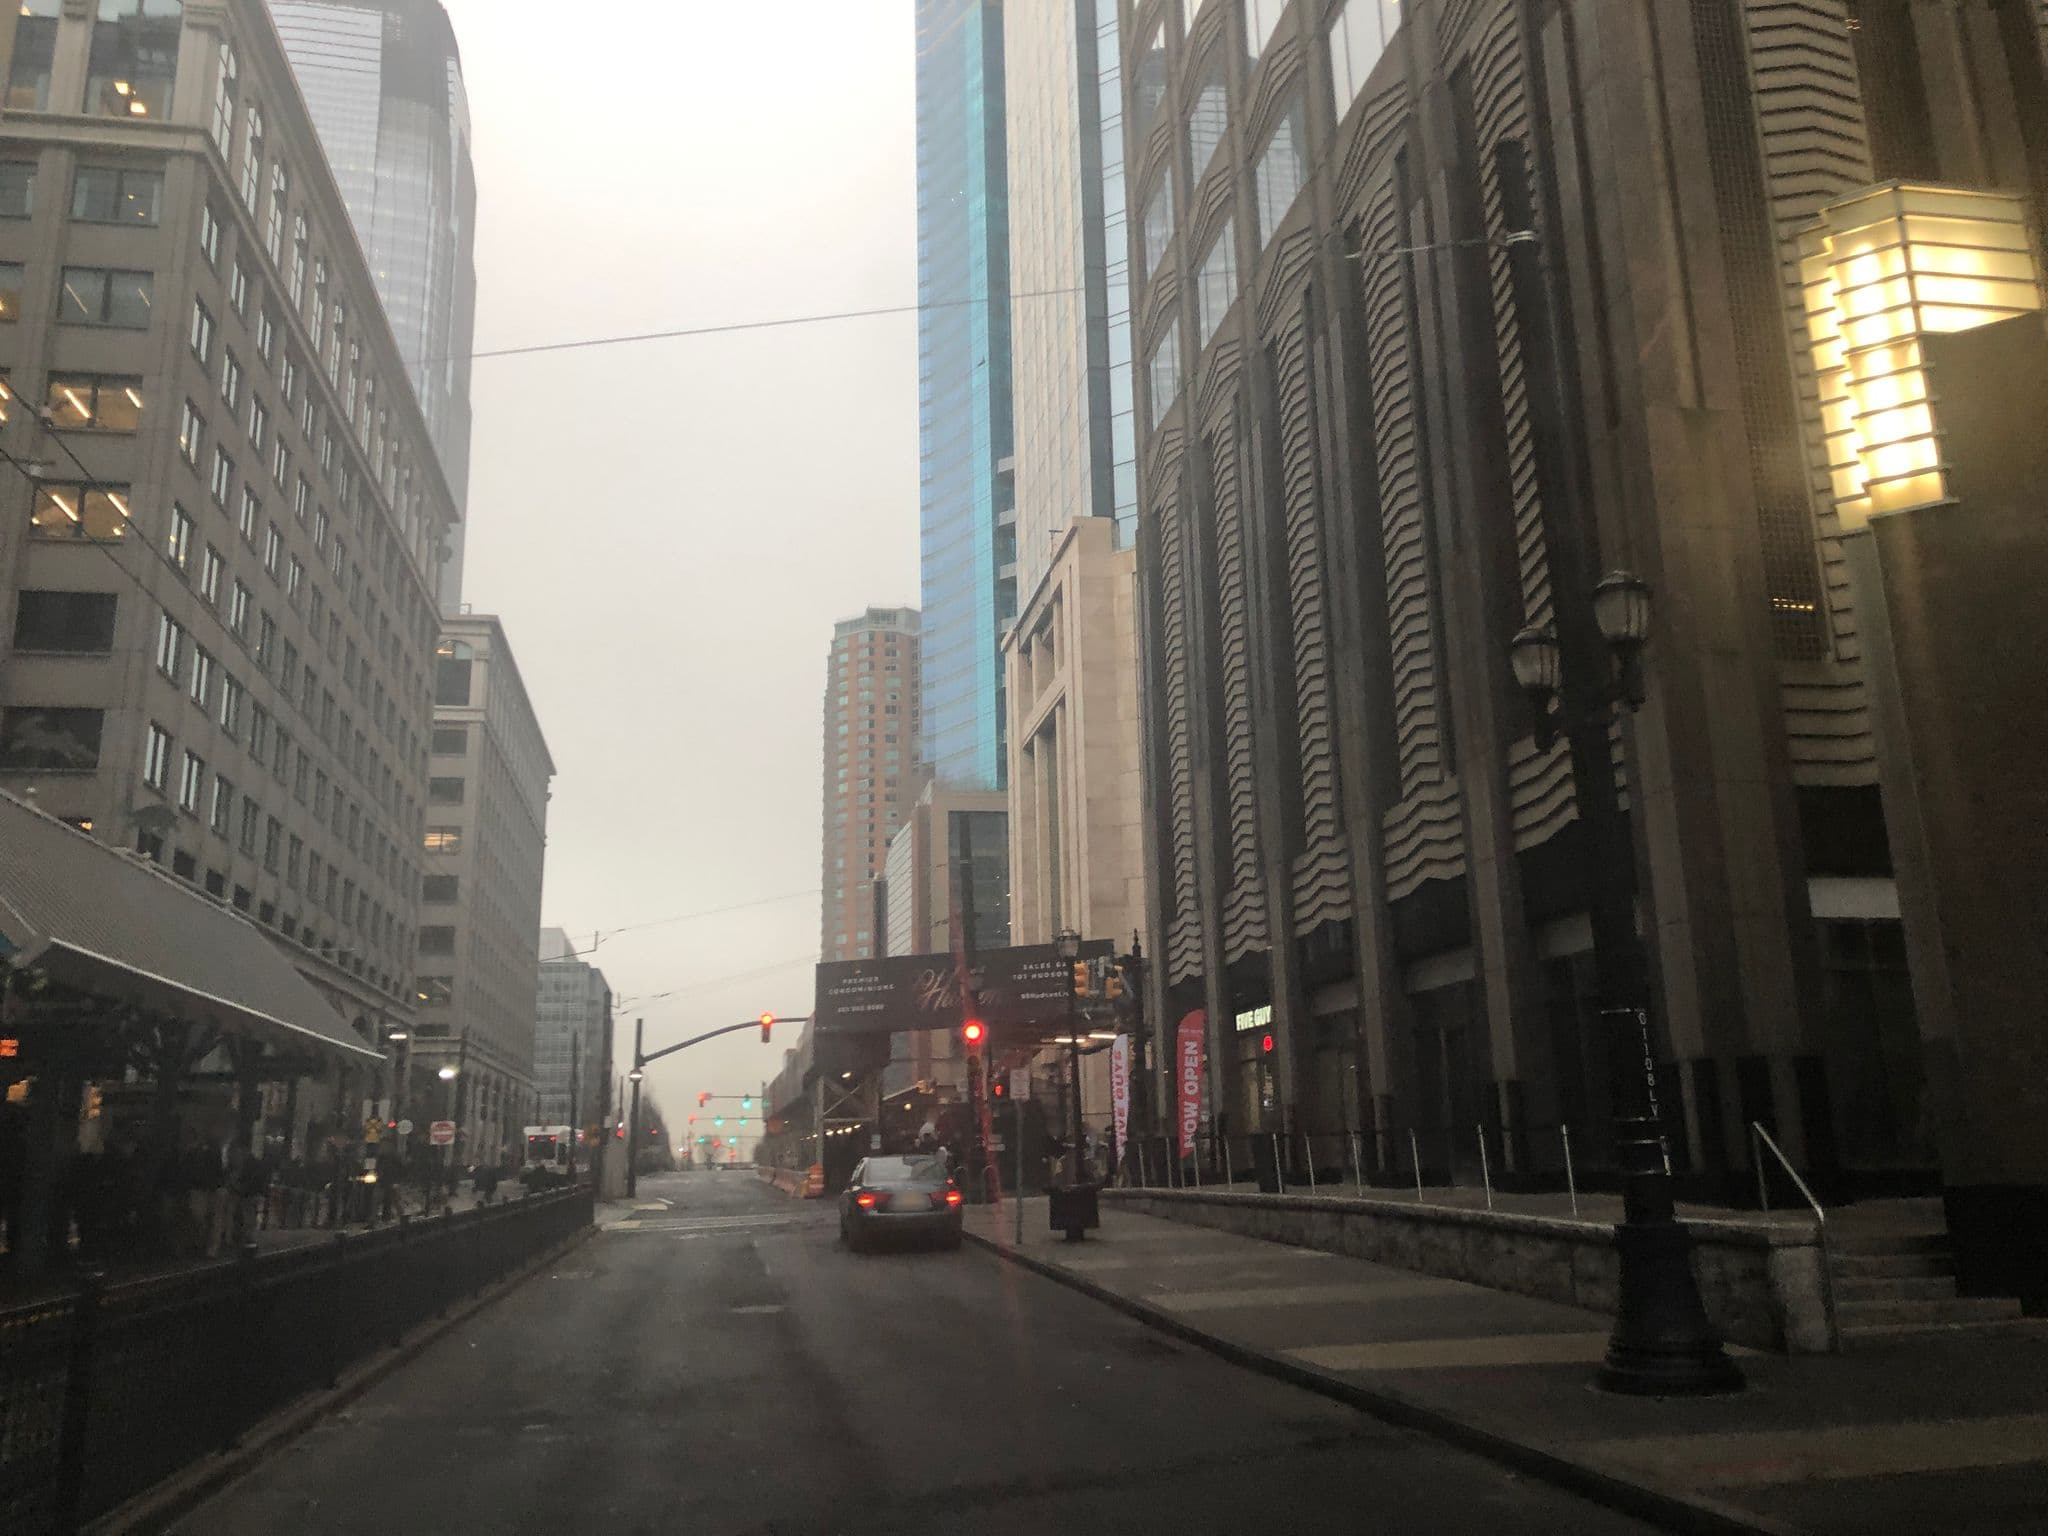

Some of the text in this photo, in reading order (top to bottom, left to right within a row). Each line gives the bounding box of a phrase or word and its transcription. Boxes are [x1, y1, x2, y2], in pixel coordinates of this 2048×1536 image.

[1235, 1010, 1254, 1031] FIVE
[1112, 1050, 1125, 1100] GUYS
[1184, 1040, 1199, 1095] OPEN
[1182, 1101, 1198, 1149] NOW
